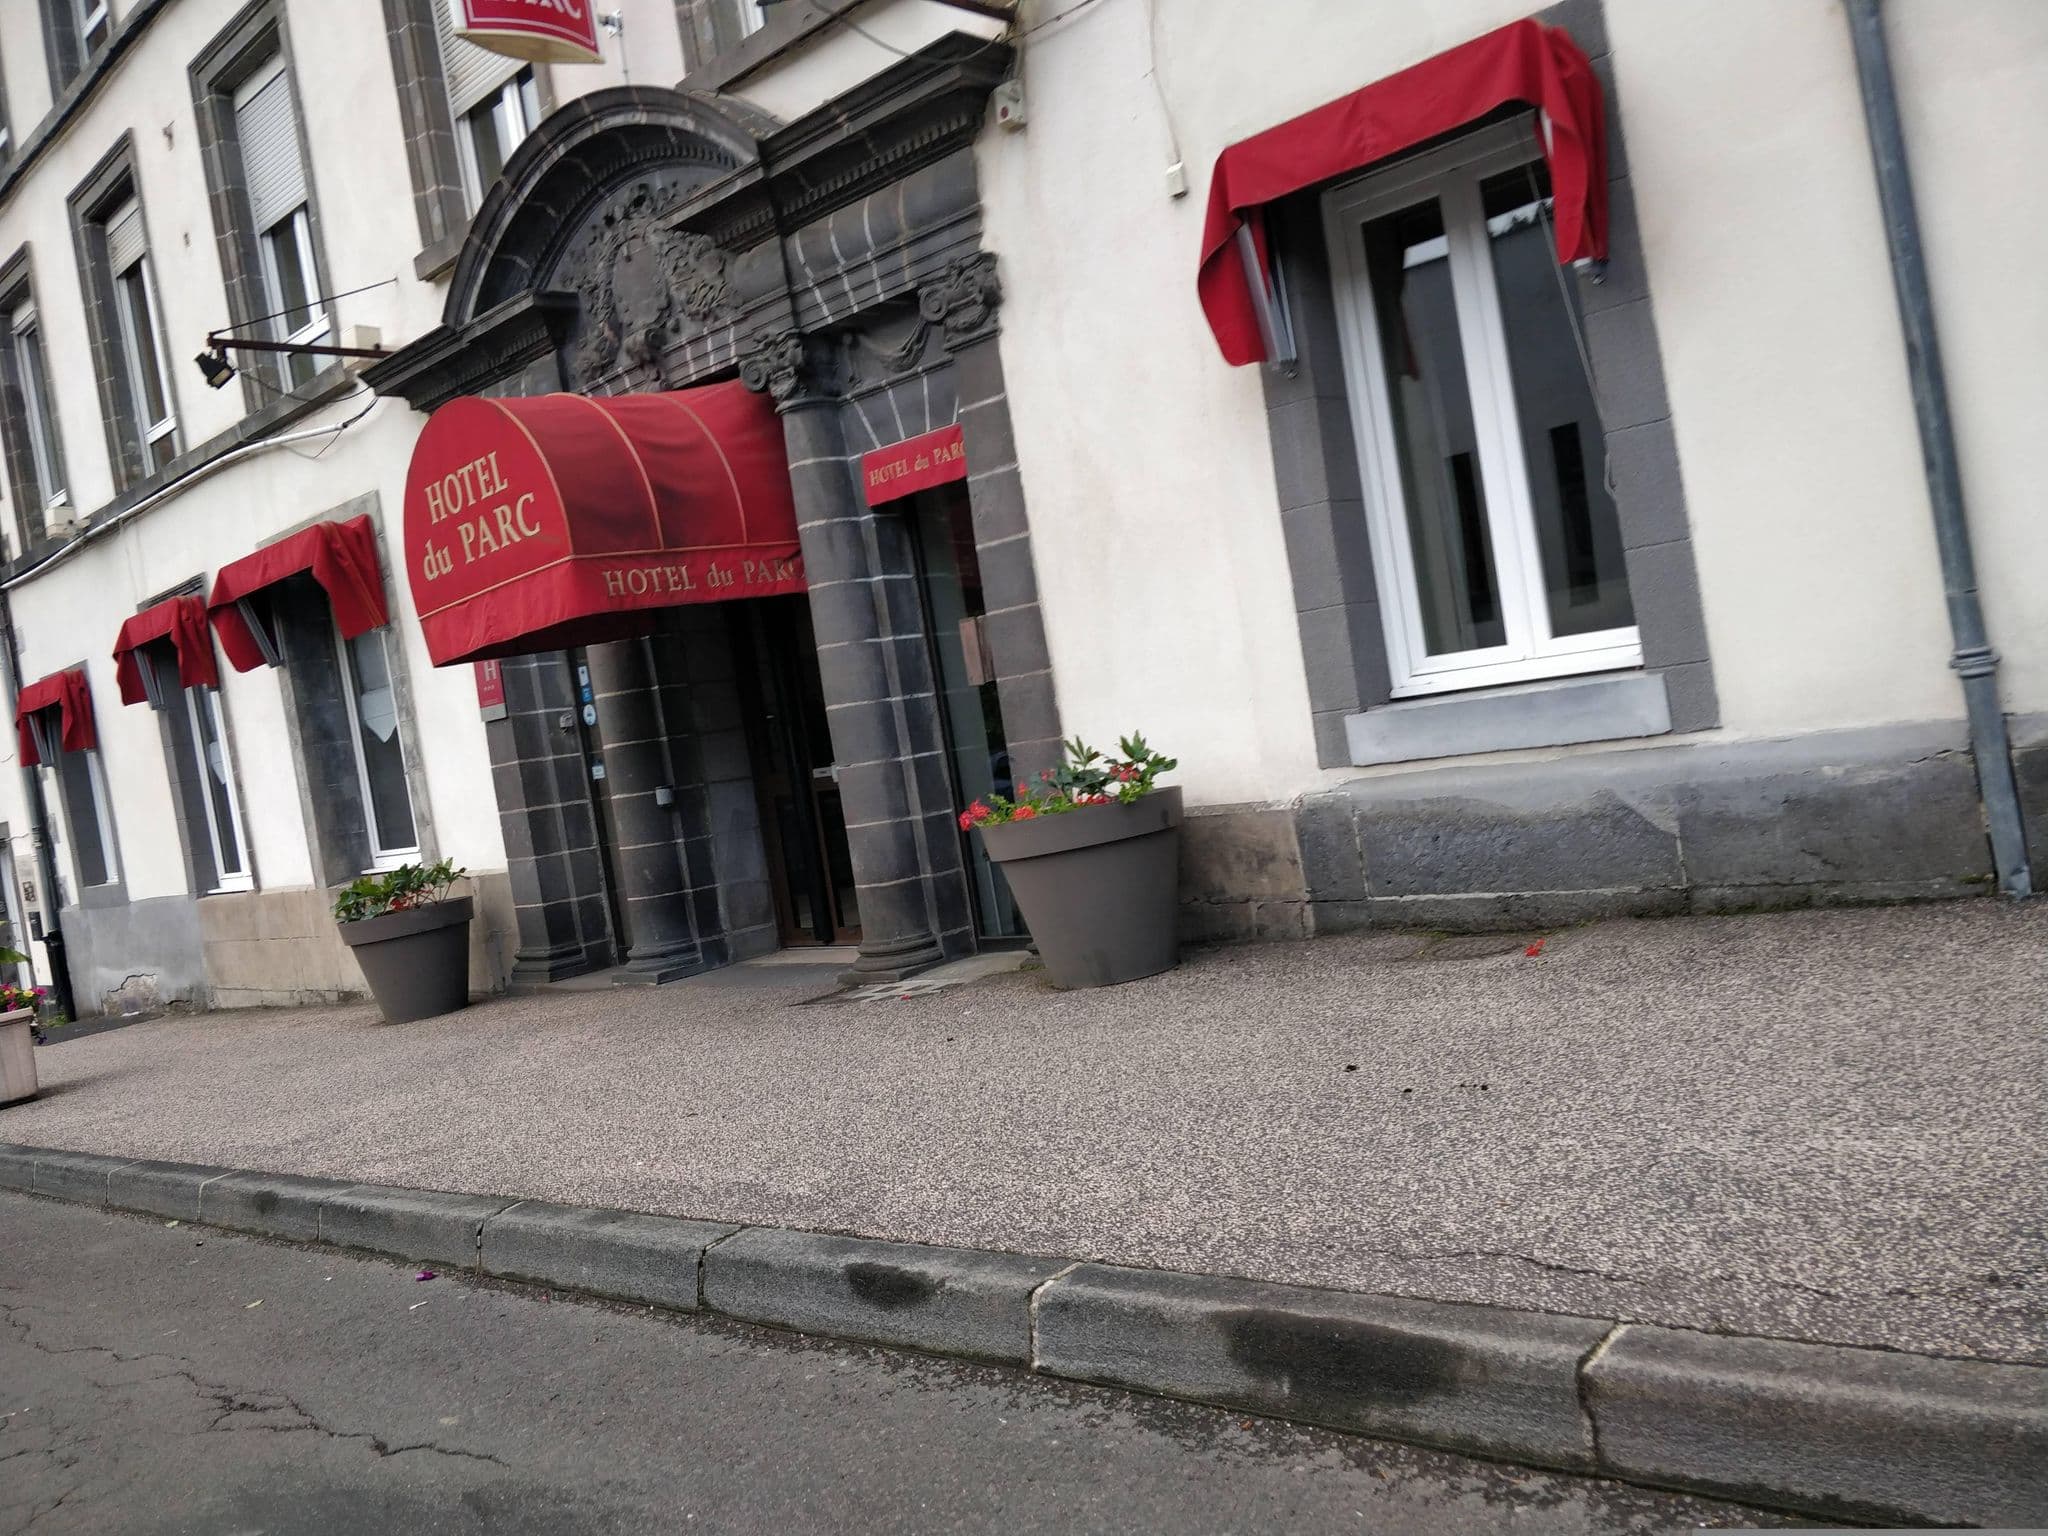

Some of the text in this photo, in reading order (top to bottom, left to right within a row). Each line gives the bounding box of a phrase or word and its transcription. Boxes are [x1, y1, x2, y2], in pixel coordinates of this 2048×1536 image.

[423, 451, 508, 525] HOTEL
[868, 459, 910, 487] HOTEL
[914, 454, 929, 471] du
[423, 492, 541, 581] du PARC
[603, 565, 697, 597] HOTEL
[705, 562, 735, 588] du
